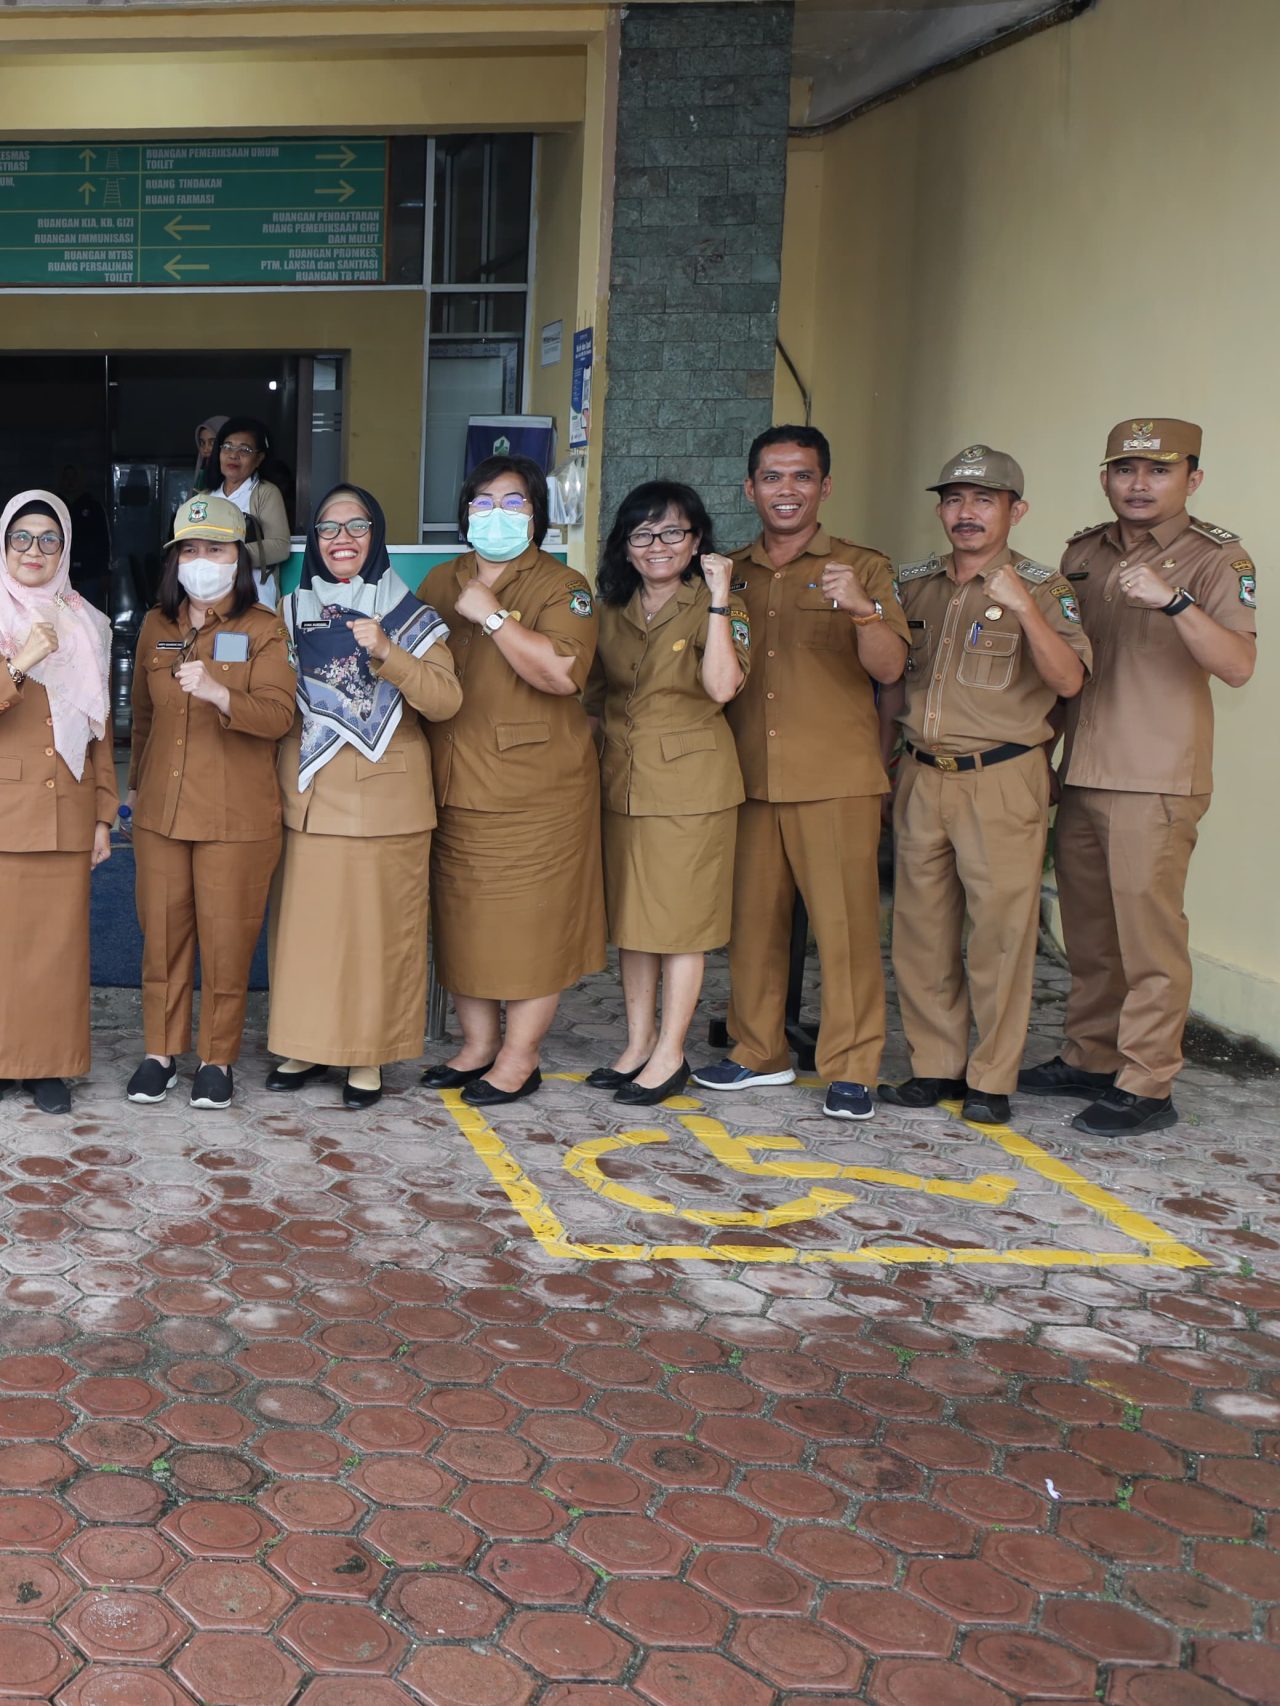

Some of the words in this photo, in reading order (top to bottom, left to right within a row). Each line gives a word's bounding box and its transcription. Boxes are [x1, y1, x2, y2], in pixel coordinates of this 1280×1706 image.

[146, 149, 187, 159] RUANGAN
[189, 148, 249, 158] PEMERIKSAAN
[251, 147, 279, 157] UMUM
[146, 159, 174, 169] TOILET
[146, 179, 175, 189] RUANG
[179, 178, 222, 188] TINDAKAN
[145, 195, 175, 205] RUANG
[177, 194, 214, 204] FARMASI
[273, 212, 315, 222] RUANGAN
[317, 211, 379, 221] PENDAFTARAN
[37, 218, 79, 228] RUANGAN
[117, 218, 134, 227] GIZI
[262, 223, 293, 233] RUANG
[295, 223, 358, 233] PEMERIKSAAN
[359, 222, 379, 232] GIGI
[34, 234, 76, 243] RUANGAN
[78, 233, 134, 243] IMMUNISASI
[328, 234, 347, 244] DAN
[349, 233, 378, 243] MULUT
[64, 250, 106, 260] RUANGAN
[108, 250, 133, 260] MTBS
[289, 248, 331, 258] RUANGAN
[48, 262, 78, 271] RUANG
[80, 261, 133, 271] PERSALINAN
[284, 260, 315, 270] LANSIA
[317, 260, 335, 269] dan
[337, 259, 378, 269] SANITASI
[104, 272, 133, 282] TOILET
[296, 271, 338, 281] RUANGAN
[341, 271, 352, 281] TB
[354, 271, 378, 280] PARU
